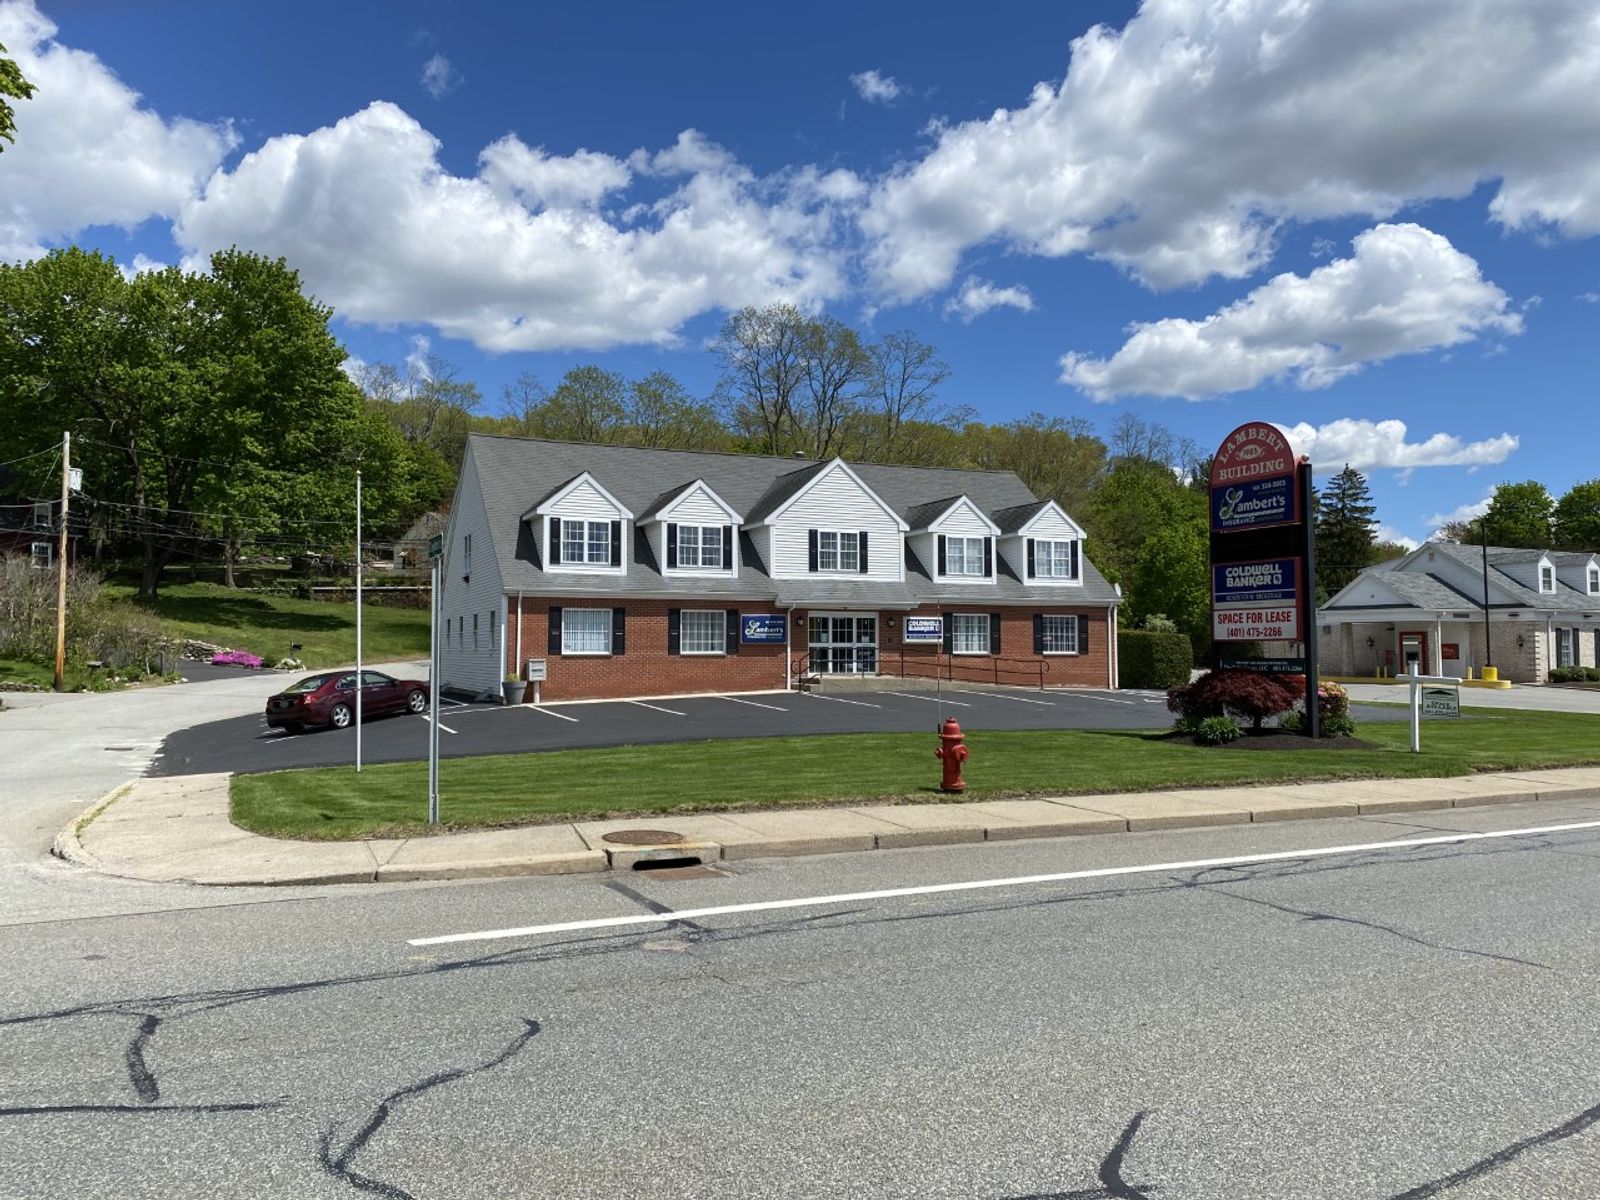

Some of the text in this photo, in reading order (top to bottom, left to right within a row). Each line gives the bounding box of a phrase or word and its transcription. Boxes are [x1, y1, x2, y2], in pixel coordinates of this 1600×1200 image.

[1219, 428, 1284, 463] LAMBERT
[1219, 458, 1285, 480] BUILDING
[1219, 488, 1286, 519] Lambert's
[1225, 563, 1282, 577] COLDWELL
[1226, 575, 1272, 588] BANKER
[1217, 610, 1292, 624] SPACE FOR LEASE
[1227, 626, 1283, 638] (401) 475-2266
